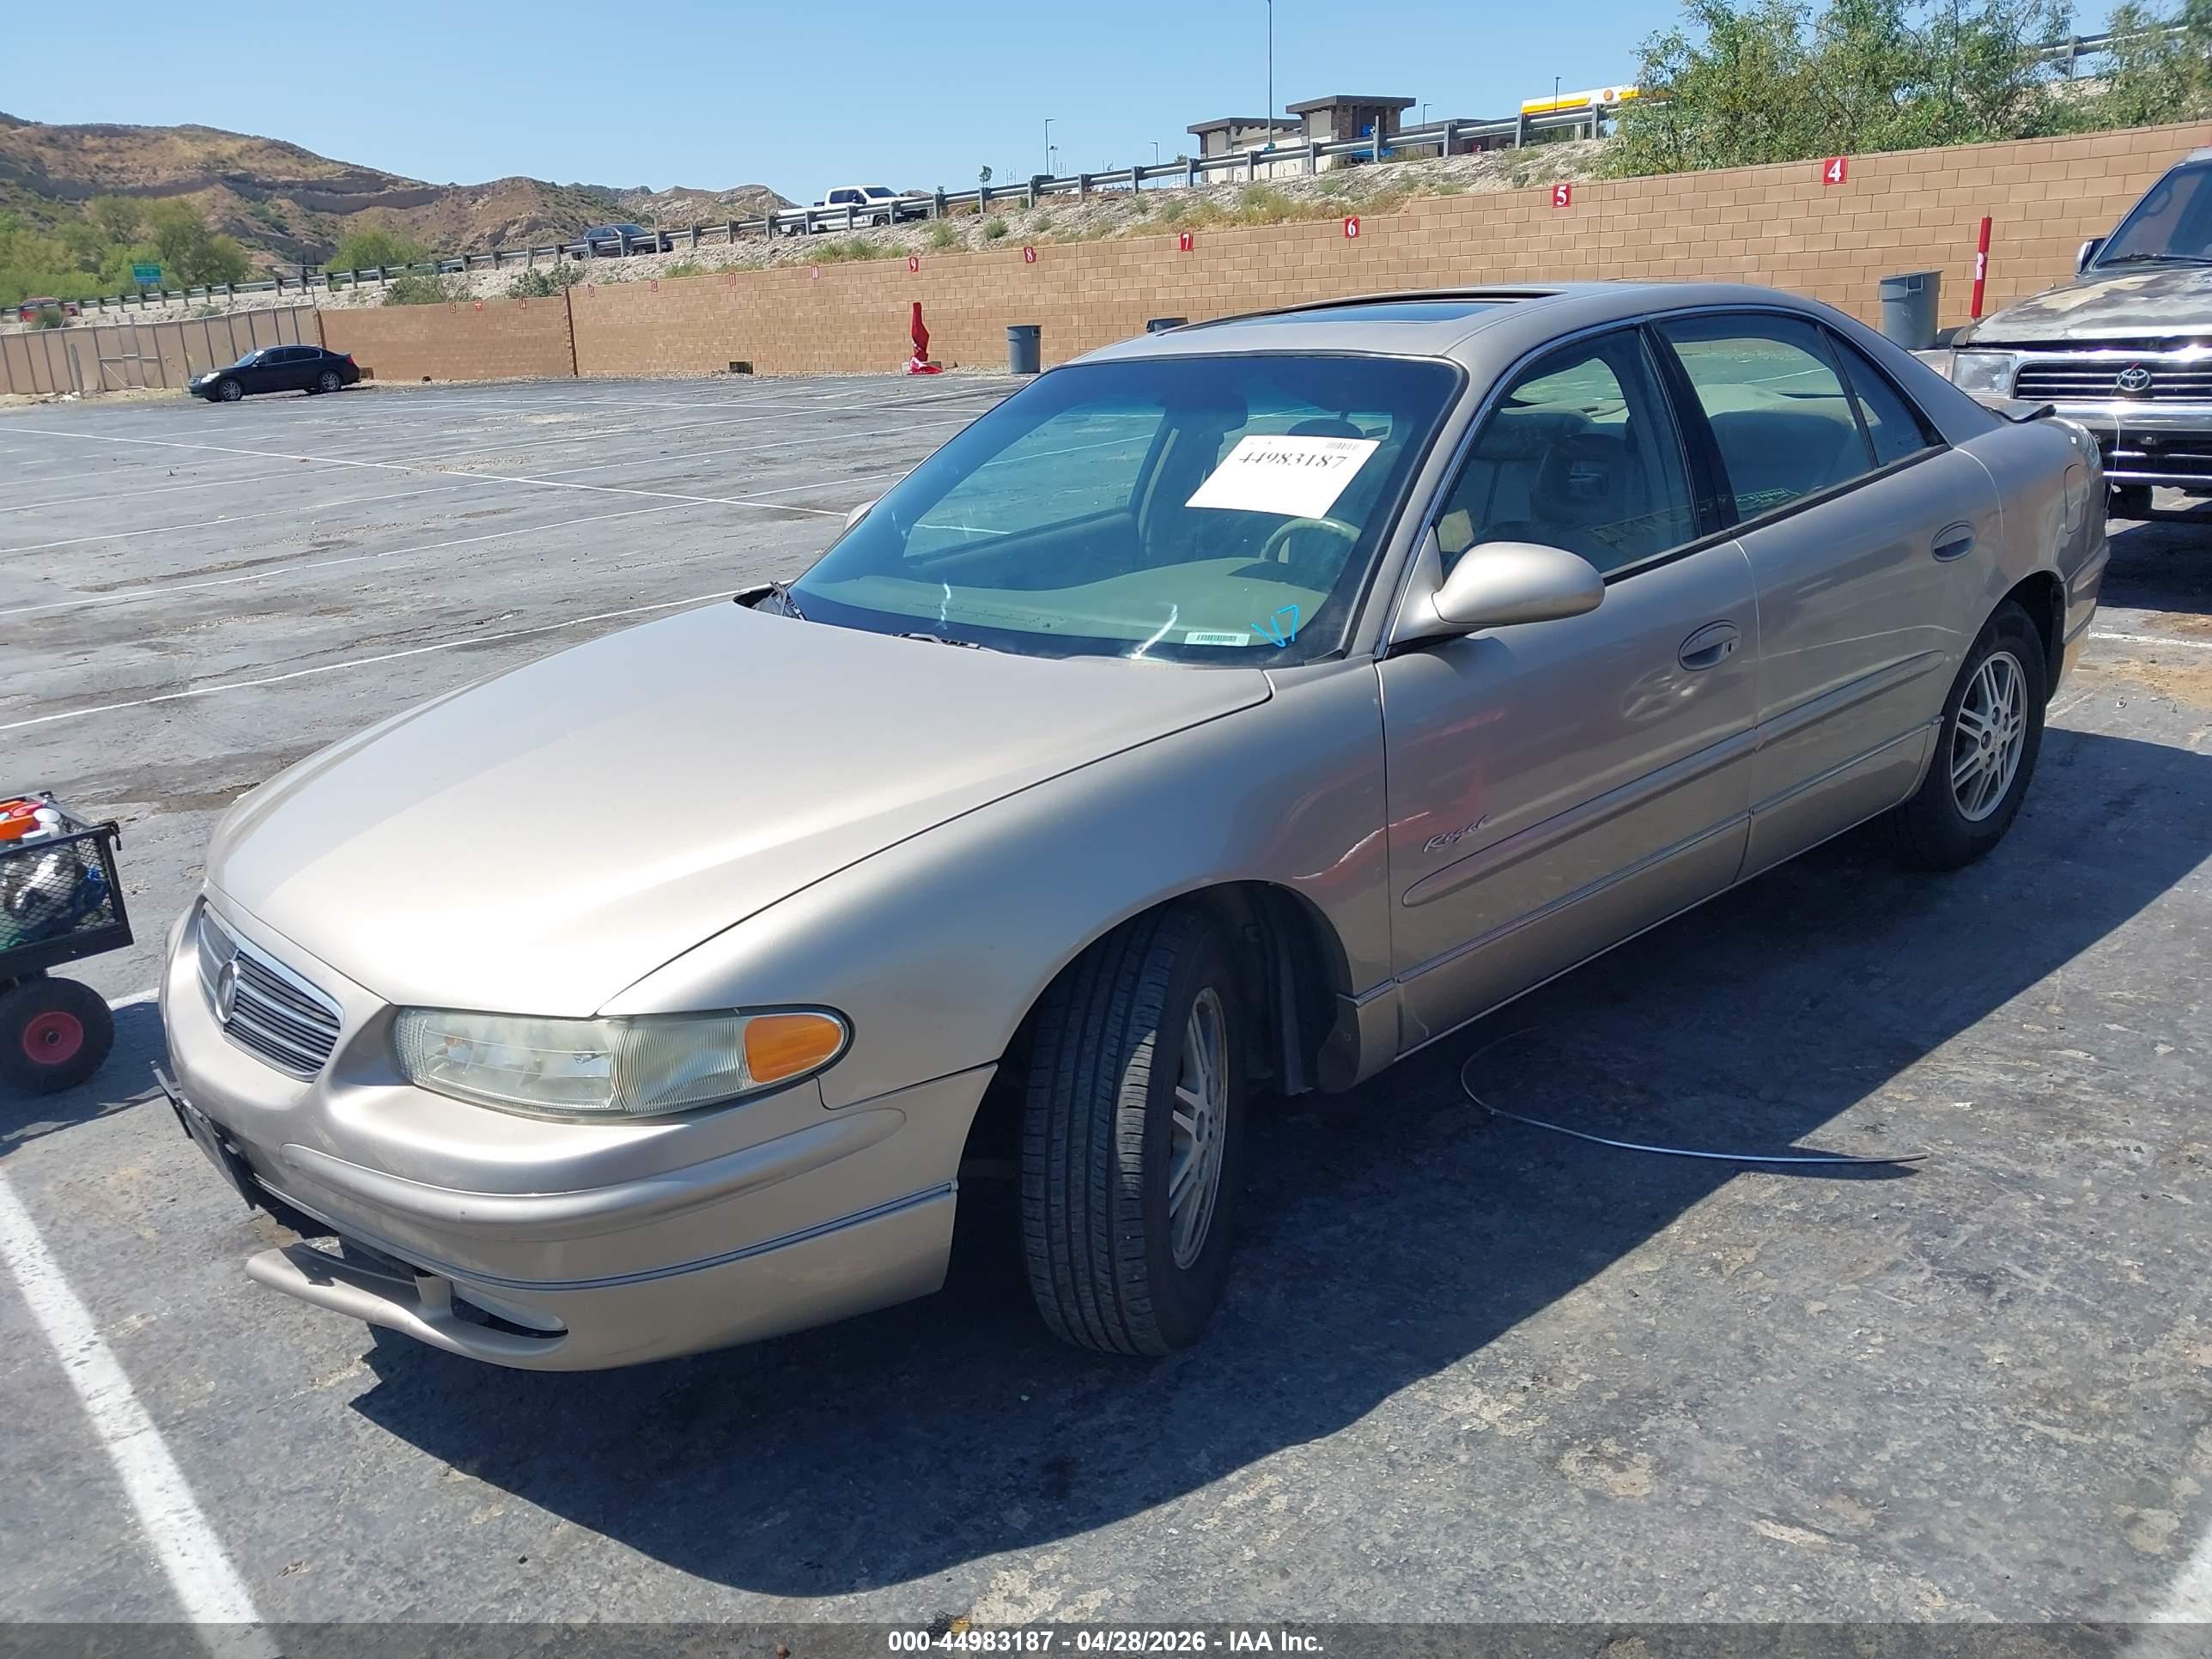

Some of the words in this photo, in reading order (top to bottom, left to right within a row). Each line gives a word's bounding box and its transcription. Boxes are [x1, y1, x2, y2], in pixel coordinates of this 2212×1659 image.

[1827, 159, 1842, 182] 4
[1556, 185, 1567, 206] 5
[1347, 218, 1357, 236] 6
[1182, 233, 1190, 250] 7
[1025, 247, 1033, 262] 8
[811, 265, 819, 279] 10
[910, 257, 917, 271] 9
[1238, 451, 1348, 469] 44983187
